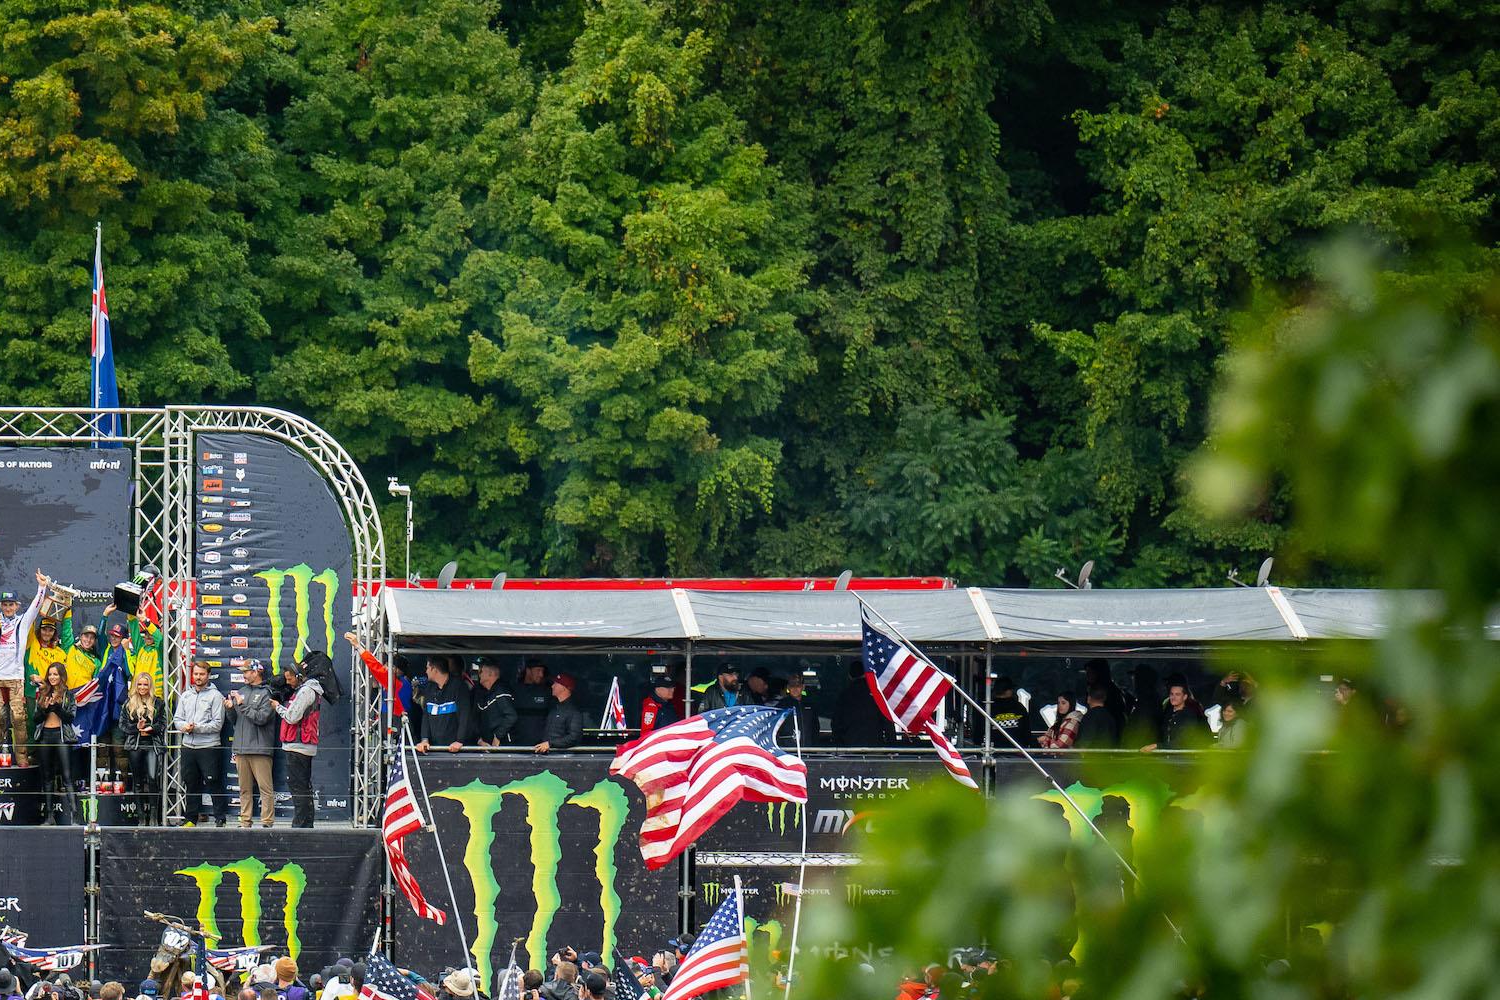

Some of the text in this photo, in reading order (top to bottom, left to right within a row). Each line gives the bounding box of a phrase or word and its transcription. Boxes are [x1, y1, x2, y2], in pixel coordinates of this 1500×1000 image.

[5, 460, 17, 468] OF
[19, 460, 53, 469] NATIONS
[820, 776, 910, 791] MONSTER
[55, 953, 77, 968] 101
